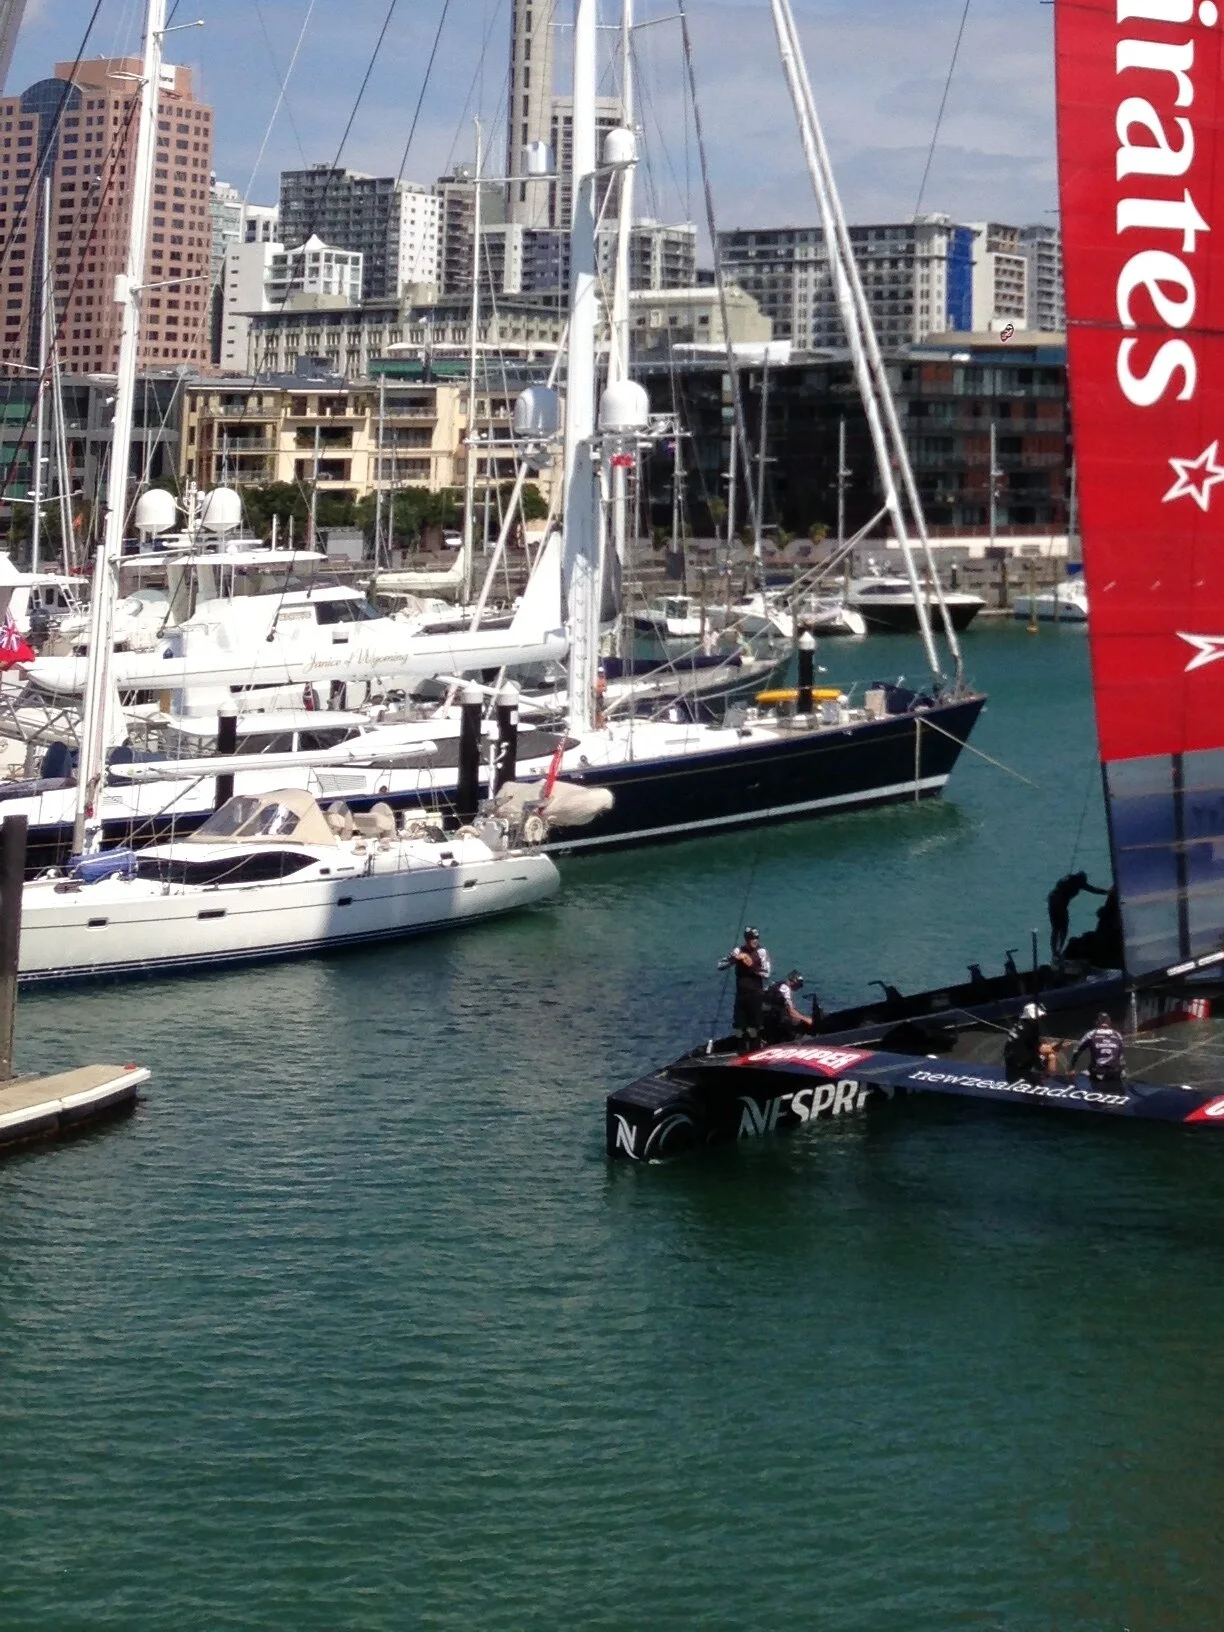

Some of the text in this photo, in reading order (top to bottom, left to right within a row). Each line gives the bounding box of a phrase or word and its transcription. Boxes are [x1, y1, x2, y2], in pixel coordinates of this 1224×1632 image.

[302, 652, 341, 675] Janice
[747, 1048, 863, 1070] CAMPER
[907, 1068, 1132, 1107] newzealand.com
